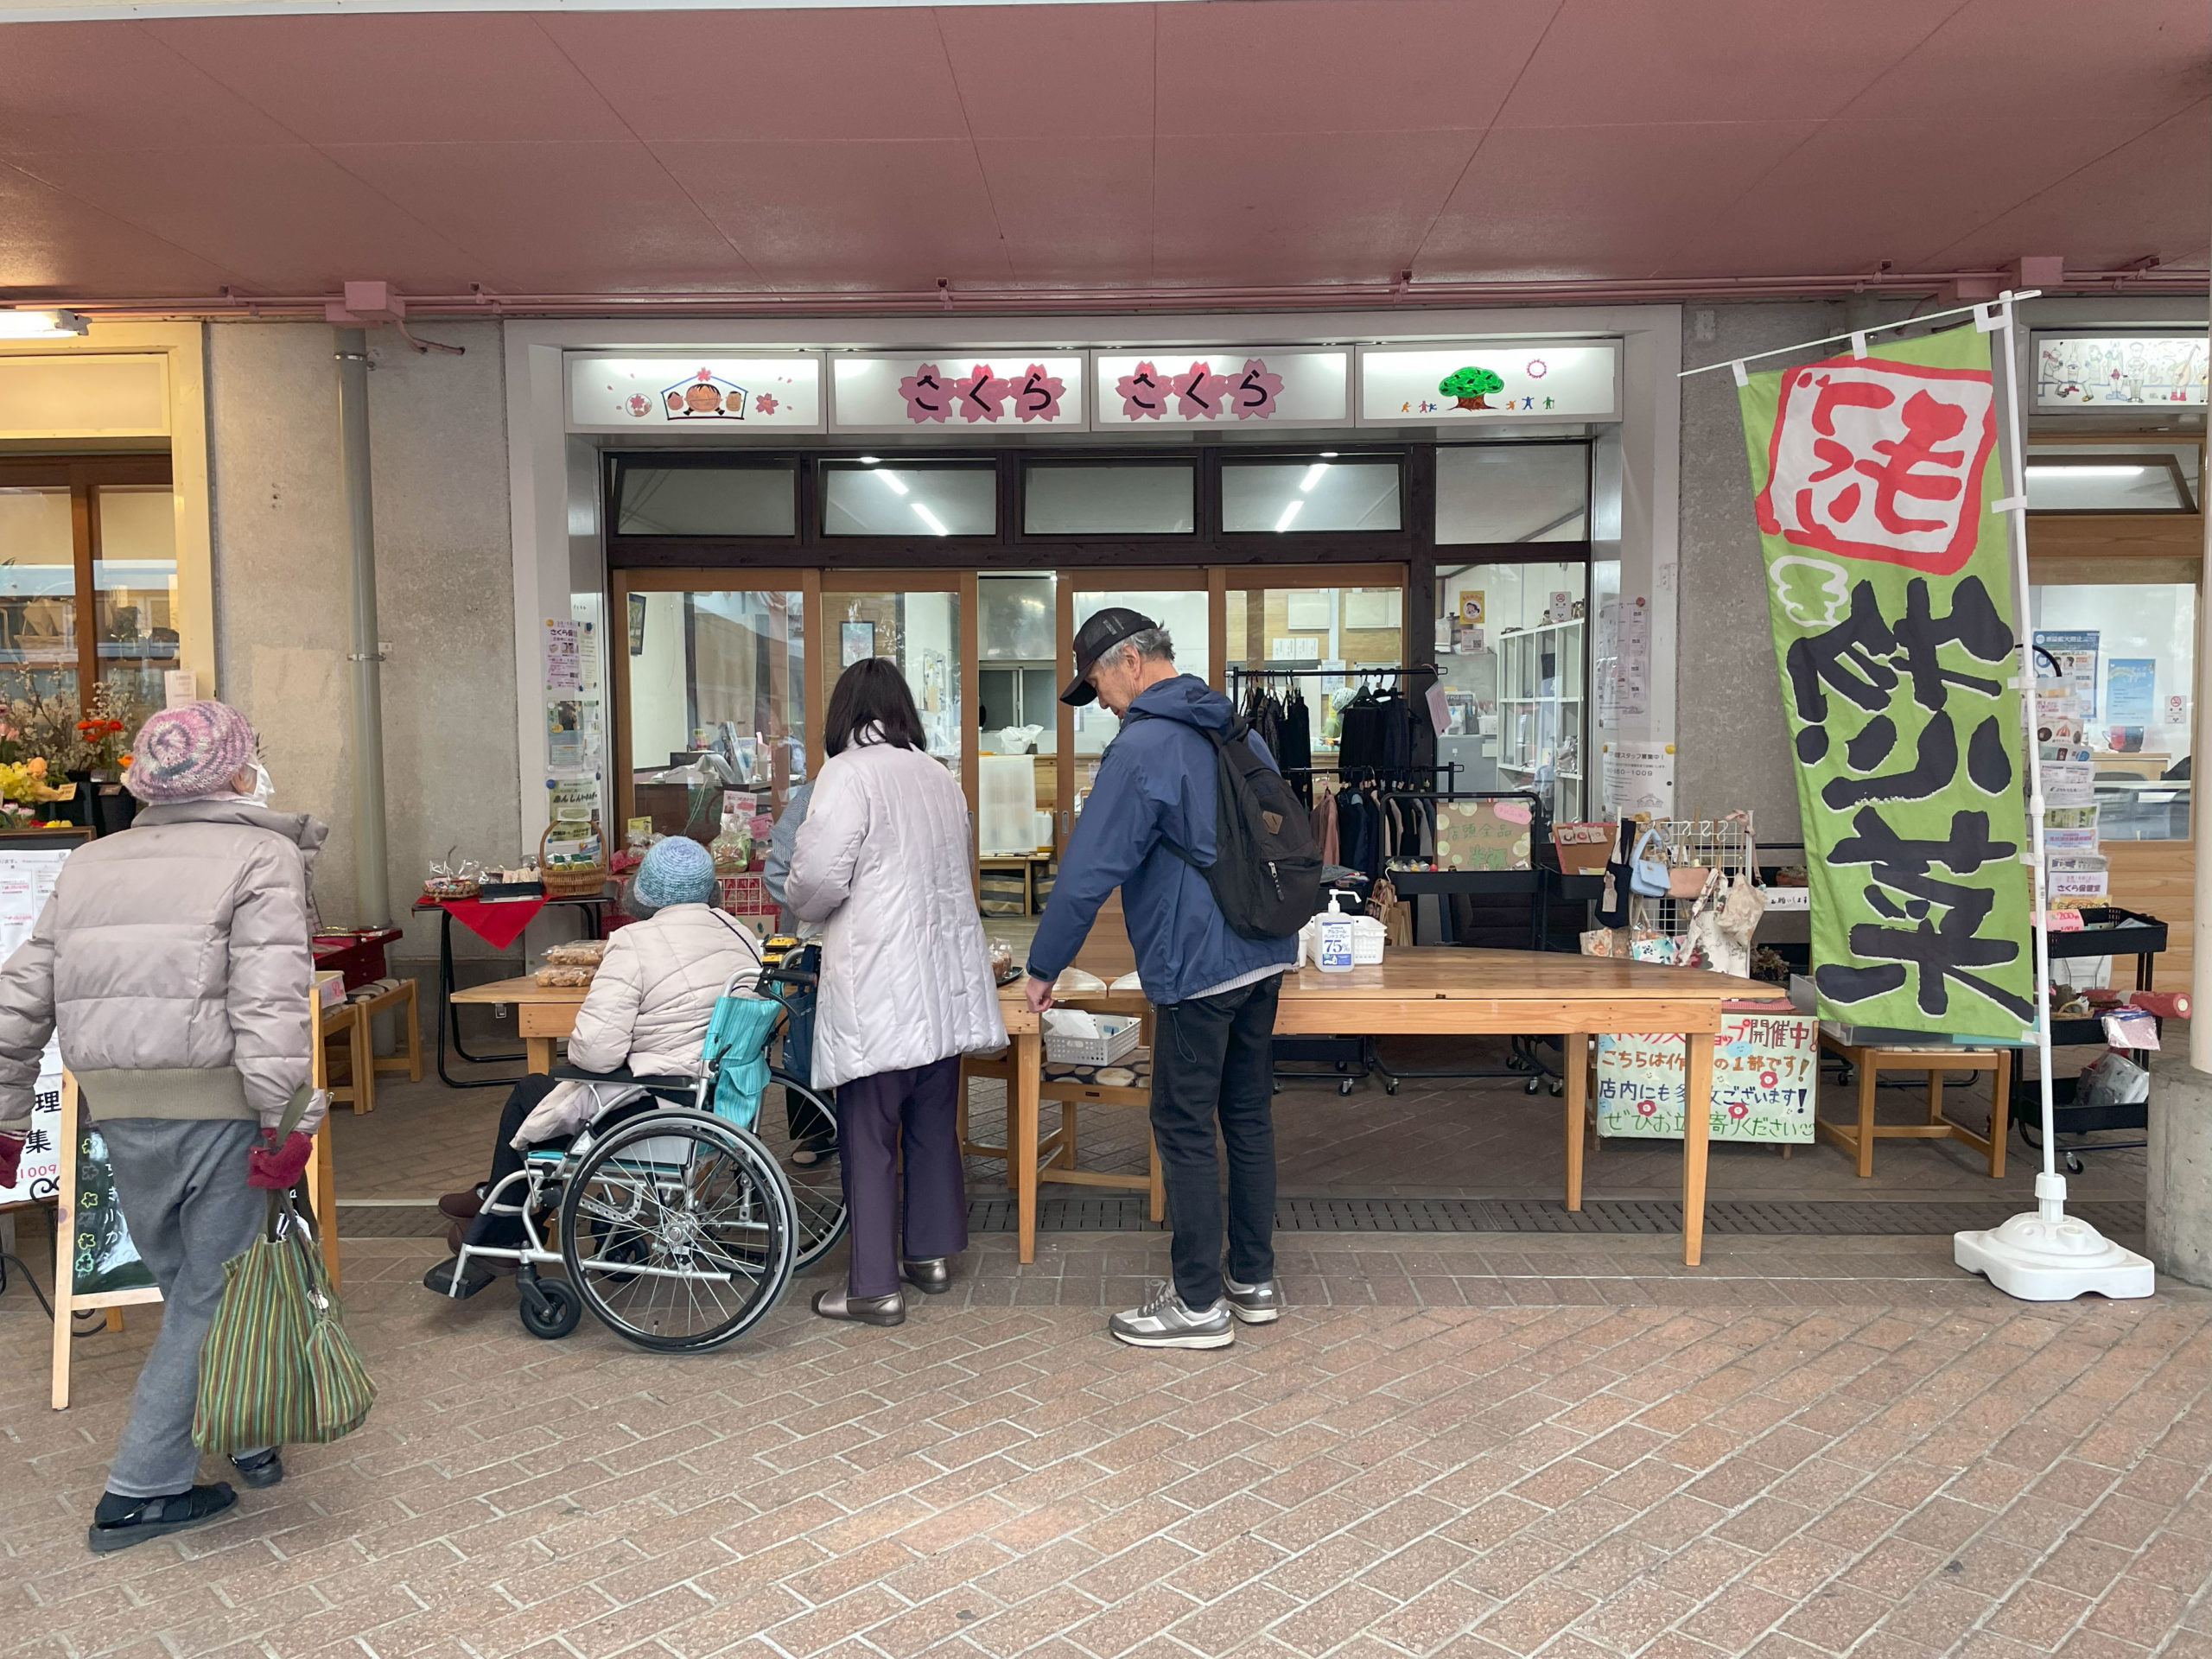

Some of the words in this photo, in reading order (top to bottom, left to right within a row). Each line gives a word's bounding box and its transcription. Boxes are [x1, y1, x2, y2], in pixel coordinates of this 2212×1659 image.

[916, 373, 1052, 413] さくら
[1133, 371, 1268, 410] さくら
[2056, 884, 2101, 893] さくら保健室
